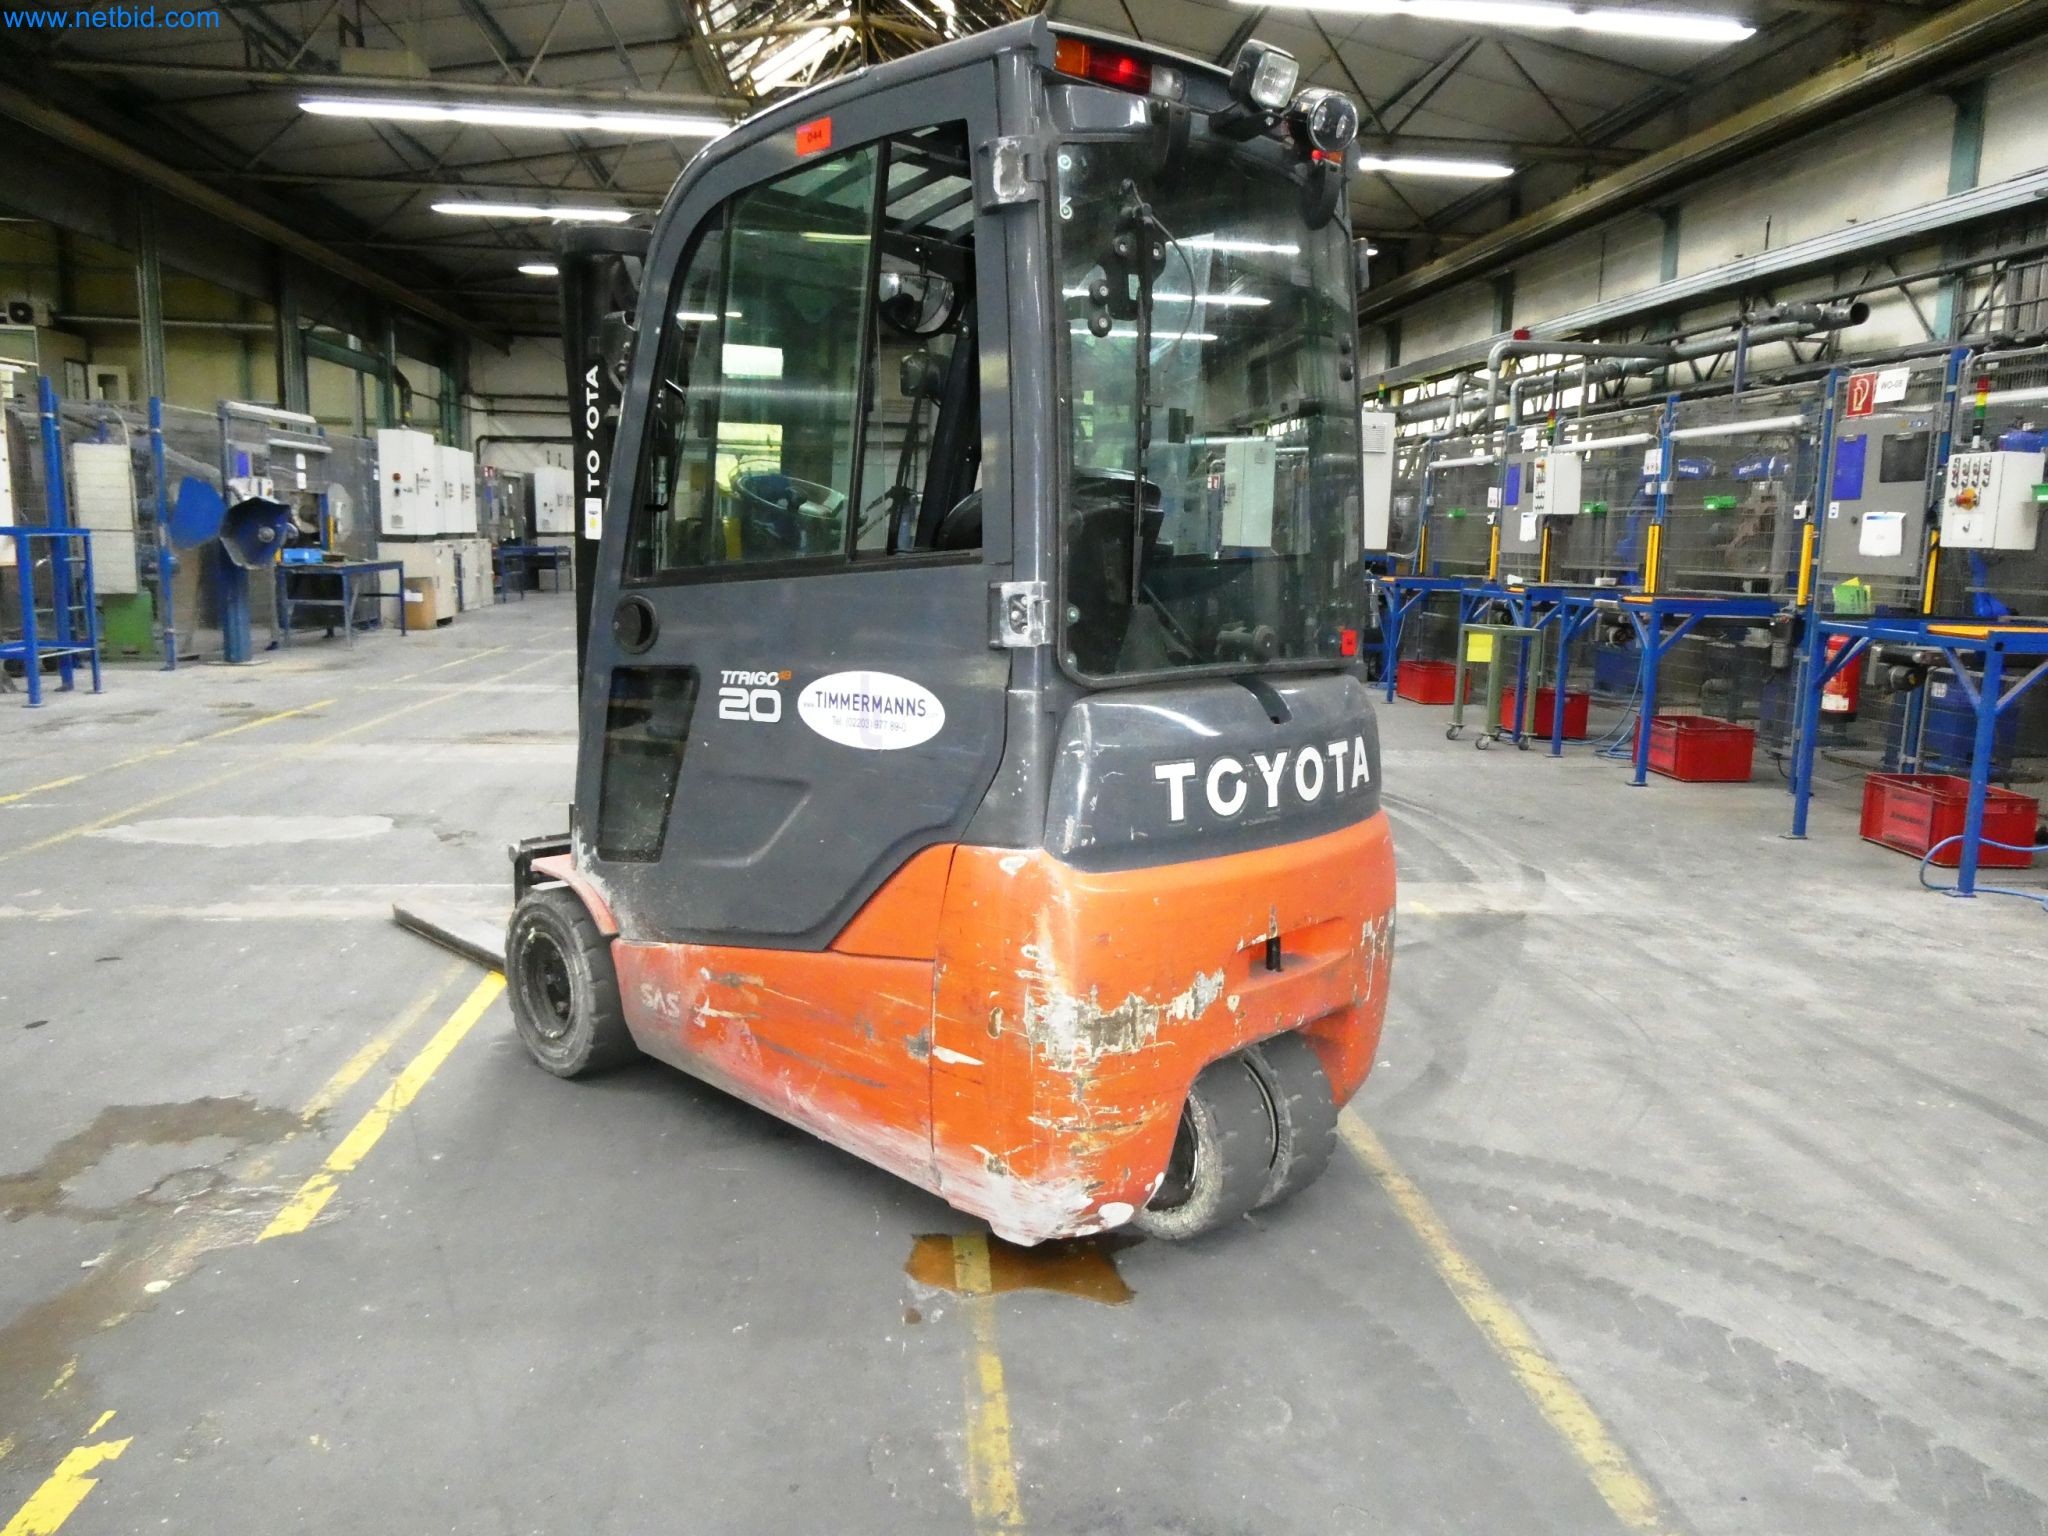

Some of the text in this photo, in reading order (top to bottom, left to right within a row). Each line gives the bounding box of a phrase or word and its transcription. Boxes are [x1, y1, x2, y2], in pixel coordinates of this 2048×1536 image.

[718, 686, 782, 723] 20
[815, 691, 927, 718] TIMMERMANNS
[1154, 735, 1370, 822] TOYOTA
